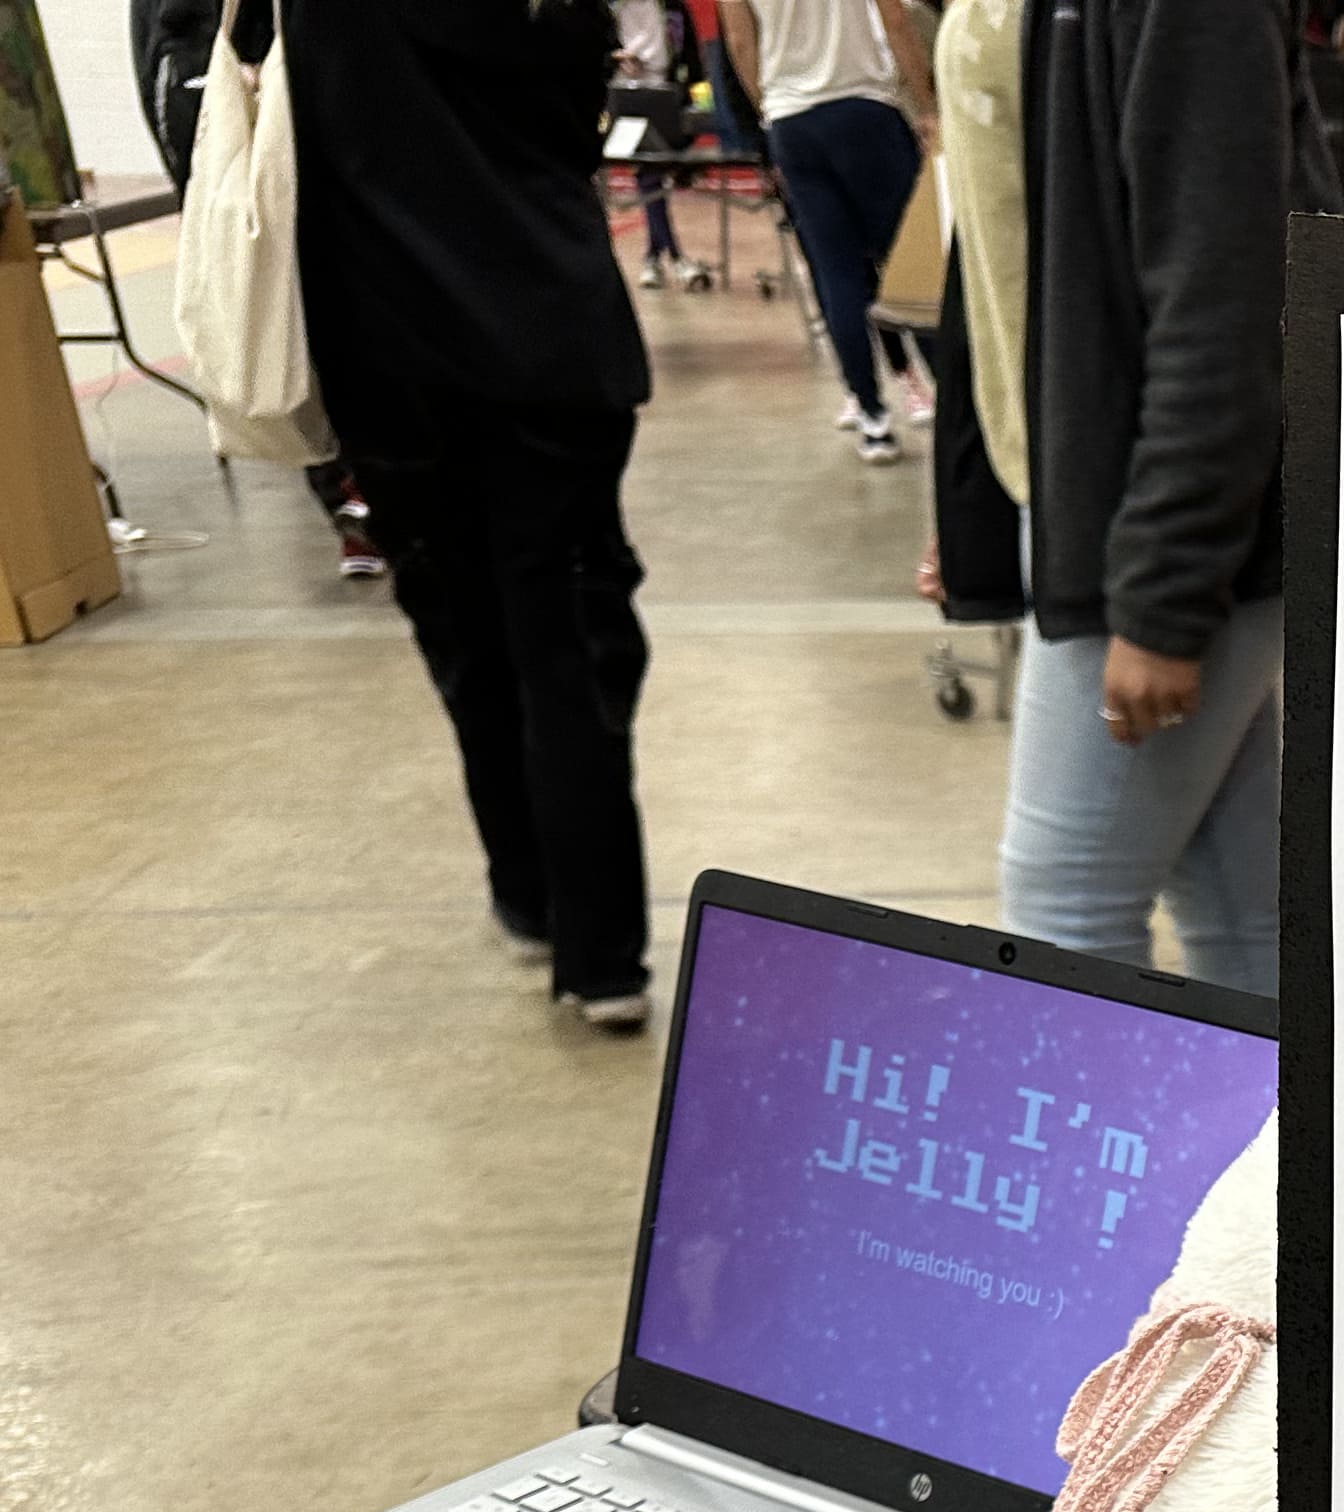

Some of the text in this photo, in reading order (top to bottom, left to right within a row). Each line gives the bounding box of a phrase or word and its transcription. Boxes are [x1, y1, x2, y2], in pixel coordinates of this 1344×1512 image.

[823, 1038, 1147, 1178] Hi! I'm
[814, 1119, 1040, 1233] Jelly
[857, 1230, 890, 1262] I'm
[895, 1244, 994, 1303] watching
[999, 1277, 1041, 1307] you
